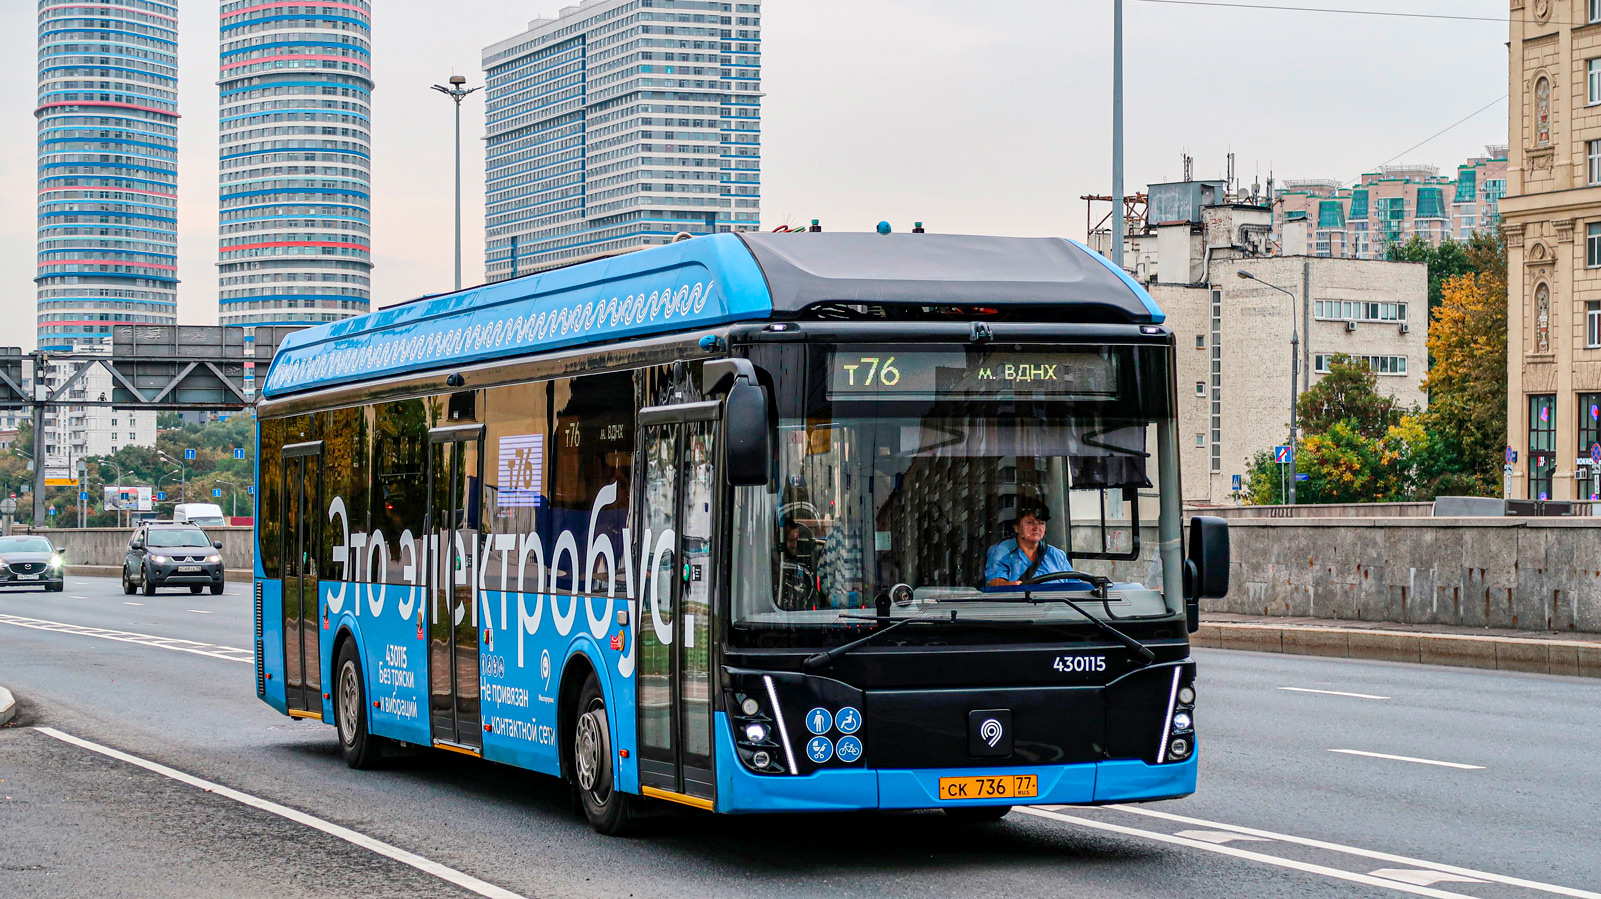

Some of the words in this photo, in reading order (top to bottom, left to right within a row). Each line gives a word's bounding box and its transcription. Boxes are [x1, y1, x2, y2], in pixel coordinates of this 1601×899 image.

[843, 356, 900, 386] т76
[977, 367, 996, 380] м.
[1004, 364, 1058, 383] ВДНХ
[564, 421, 581, 448] т76
[607, 423, 624, 442] ВДНХ
[326, 495, 387, 617] Это
[398, 480, 695, 679] электробус.
[385, 644, 408, 669] 430115
[1052, 656, 1107, 672] 430115
[378, 661, 391, 685] Без
[391, 668, 415, 692] тряски
[379, 695, 385, 712] и
[385, 691, 418, 720] вибраций
[480, 675, 491, 702] Не
[491, 684, 529, 709] привязан
[490, 715, 538, 743] контактной
[538, 725, 556, 747] сети
[947, 783, 968, 797] СК
[975, 778, 1006, 796] 736
[1015, 776, 1032, 790] 77
